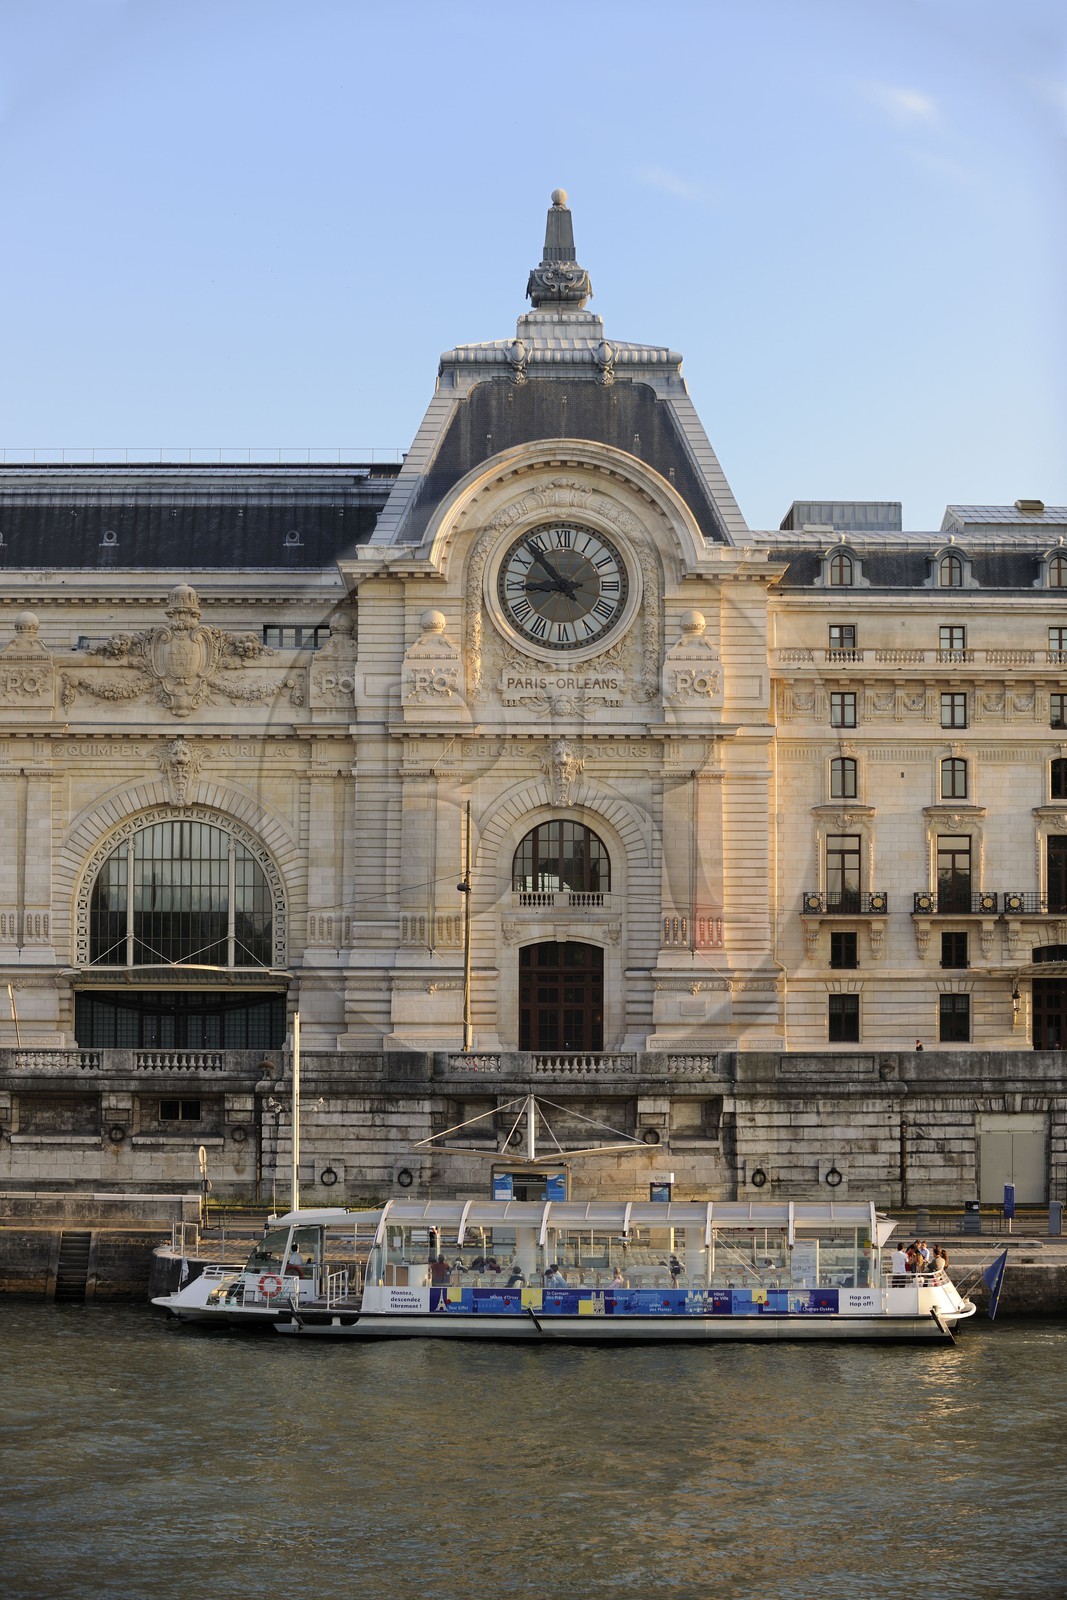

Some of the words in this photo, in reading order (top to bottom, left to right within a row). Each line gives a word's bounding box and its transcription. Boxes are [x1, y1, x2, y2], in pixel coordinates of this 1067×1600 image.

[555, 530, 571, 548] XII
[581, 537, 592, 553] I
[512, 554, 532, 570] X
[595, 555, 613, 569] II
[601, 580, 619, 592] III
[511, 599, 532, 623] VIII
[593, 599, 615, 620] IIII
[529, 616, 547, 638] VII
[557, 624, 570, 641] VI
[582, 619, 594, 636] V
[507, 677, 618, 689] PARIS-ORLEANS
[68, 745, 142, 758] QUIMPER
[218, 745, 294, 758] AURILLAC
[477, 745, 526, 757] BLOIS
[596, 745, 649, 758] TOURS
